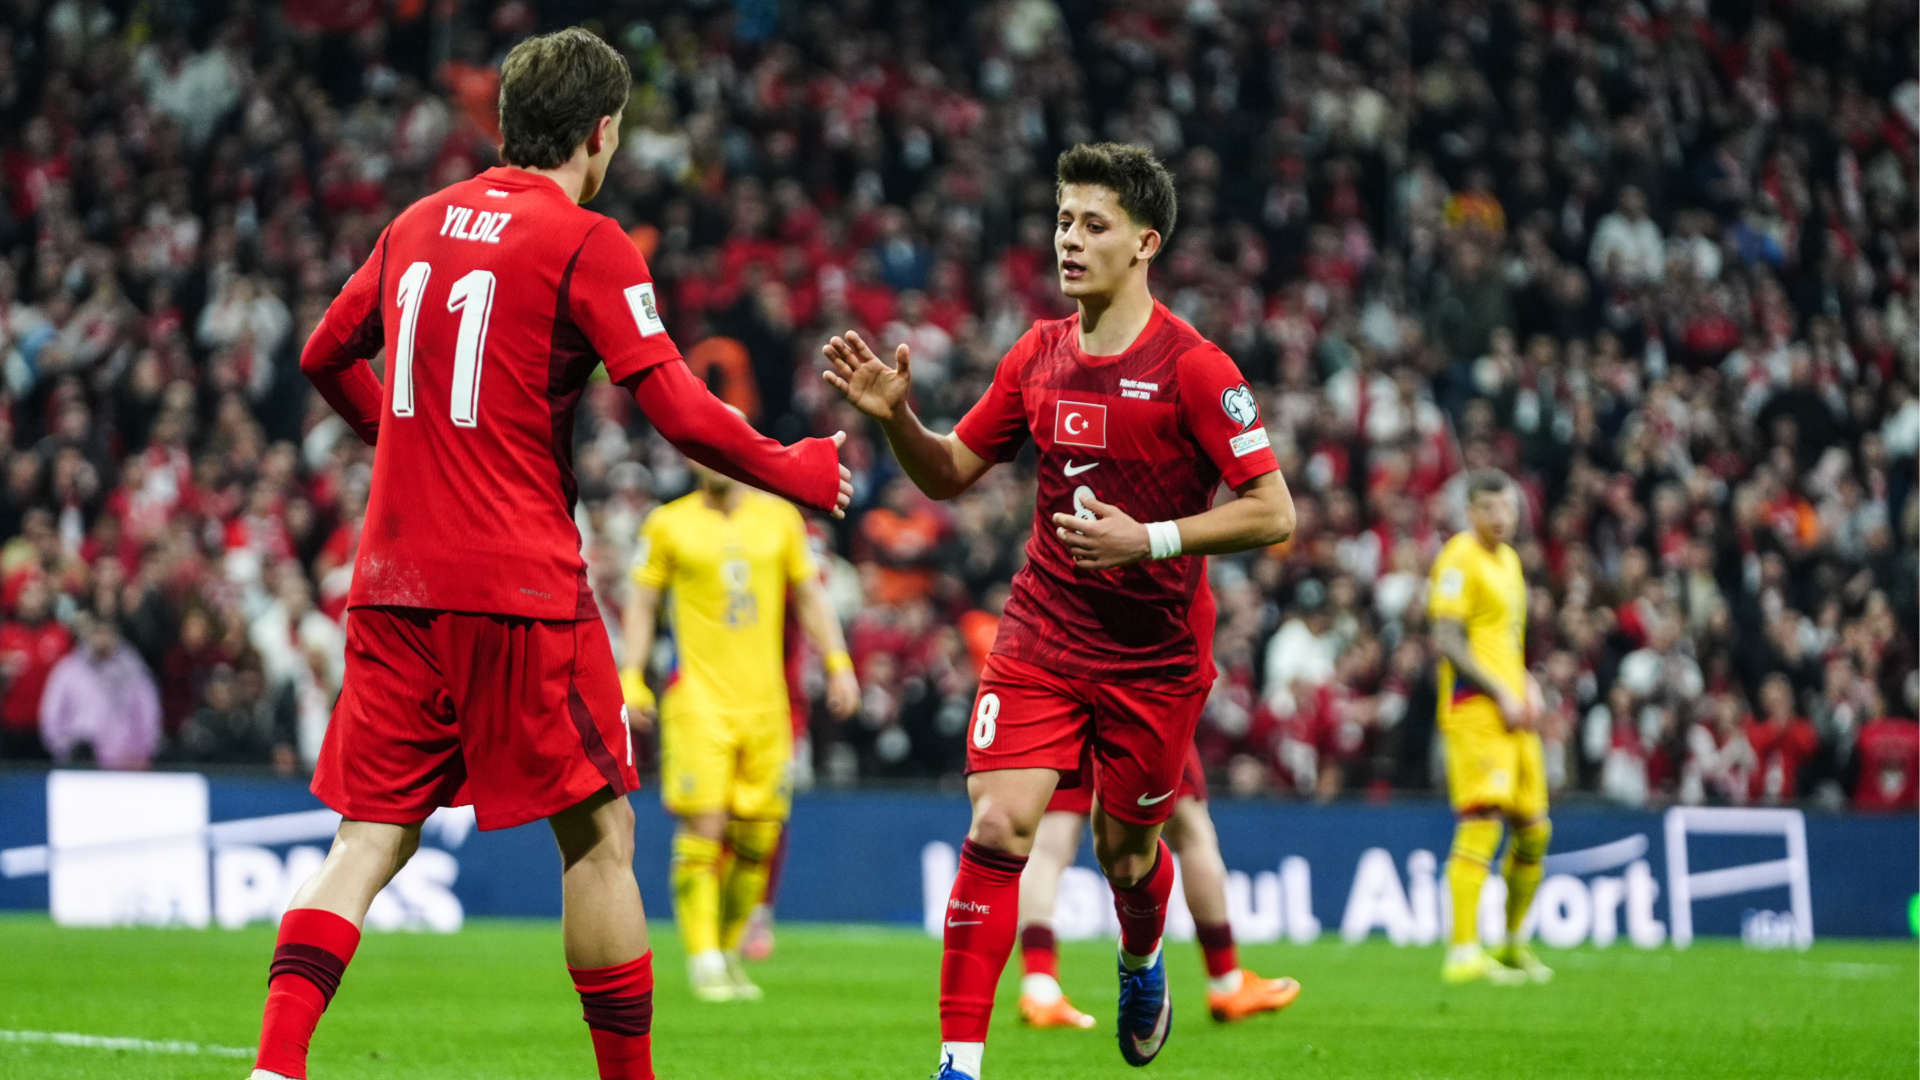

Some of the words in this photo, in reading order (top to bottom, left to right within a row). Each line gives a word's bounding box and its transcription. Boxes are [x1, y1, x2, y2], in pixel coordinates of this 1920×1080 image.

[440, 205, 512, 243] YILDIZ
[392, 262, 496, 427] 11
[973, 693, 1000, 749] 8
[949, 898, 990, 914] TÜRKİYE
